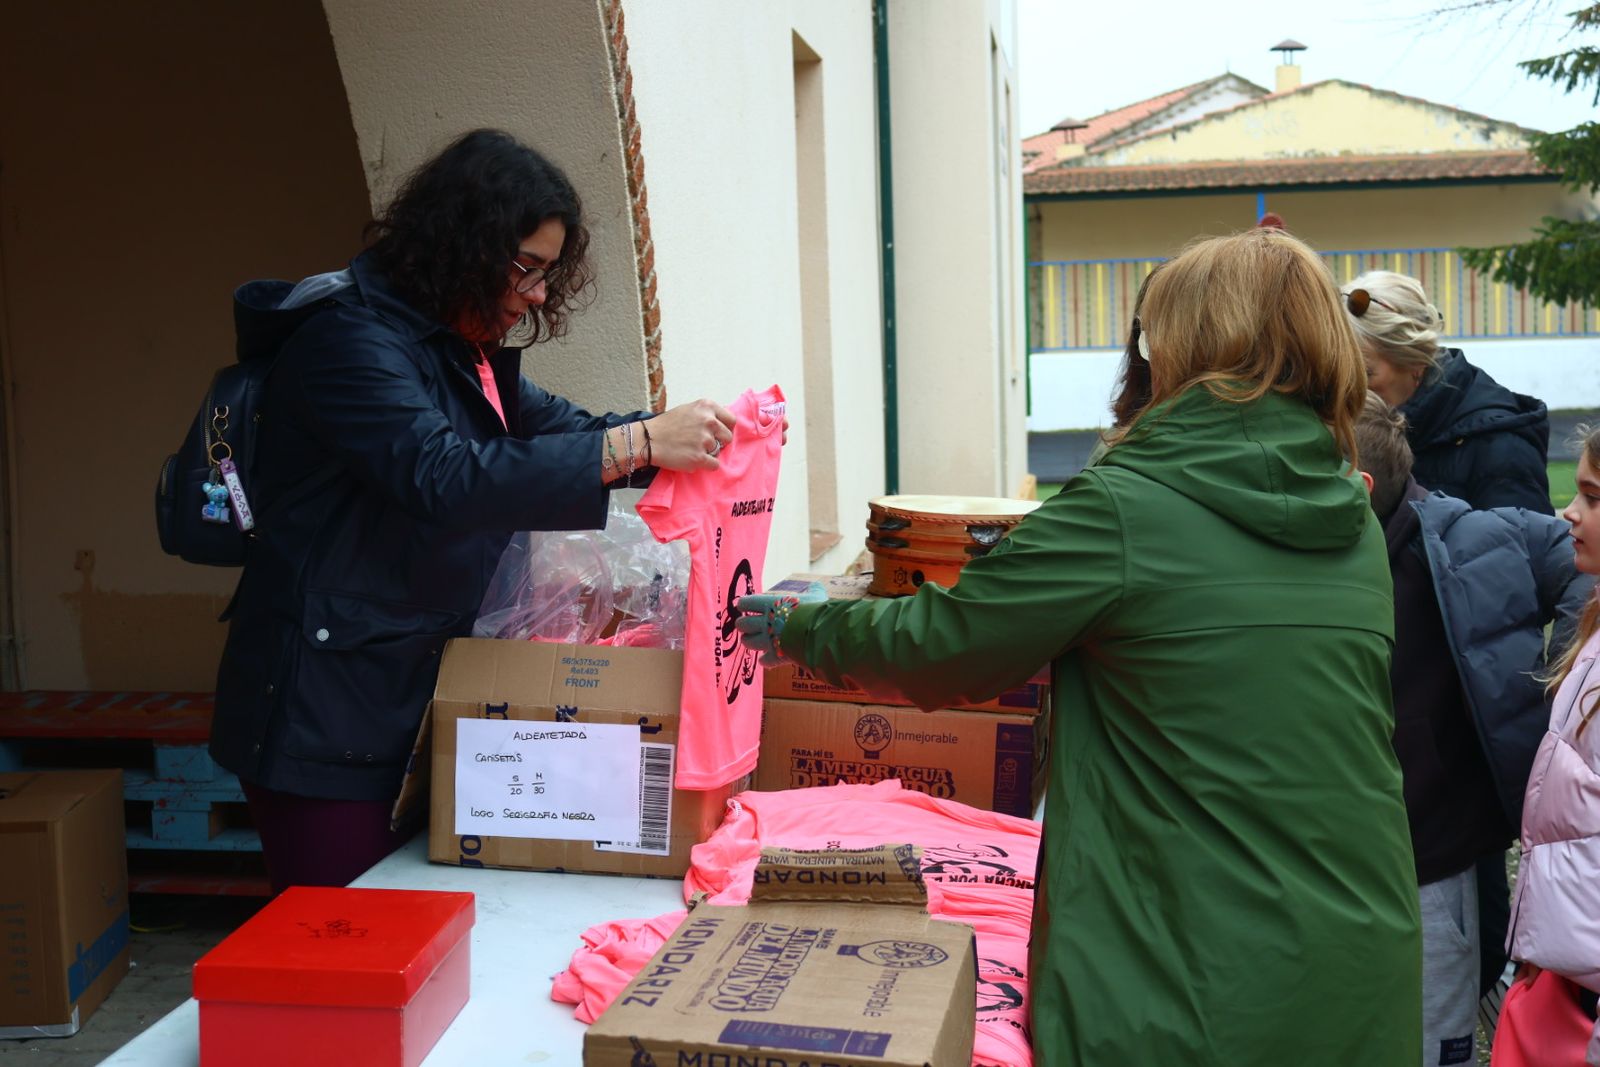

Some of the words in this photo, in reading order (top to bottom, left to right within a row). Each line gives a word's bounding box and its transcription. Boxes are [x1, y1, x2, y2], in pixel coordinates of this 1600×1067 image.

[714, 611, 722, 631] LA
[714, 637, 722, 667] POR
[565, 677, 600, 689] FRONT
[513, 731, 588, 741] ALDEATEJADA
[894, 729, 959, 745] Inmejorable
[791, 748, 812, 758] PARA
[824, 751, 834, 759] ES
[791, 757, 817, 772] LA
[820, 760, 891, 779] MEJOR
[894, 764, 954, 784] AGUA
[510, 787, 523, 796] 20
[533, 786, 545, 795] 30
[470, 807, 494, 819] LOGO
[562, 811, 595, 821] NEGRA
[794, 855, 836, 865] MINERAL
[839, 855, 885, 865] NATURAL
[754, 869, 886, 885] MONDAR
[747, 923, 798, 951] DEL
[621, 917, 724, 1007] MONDARIZ
[763, 939, 814, 978] MEJOR
[708, 950, 783, 1012] MUNDO
[743, 977, 791, 1012] AGUA
[862, 969, 908, 1017] Inmejorable
